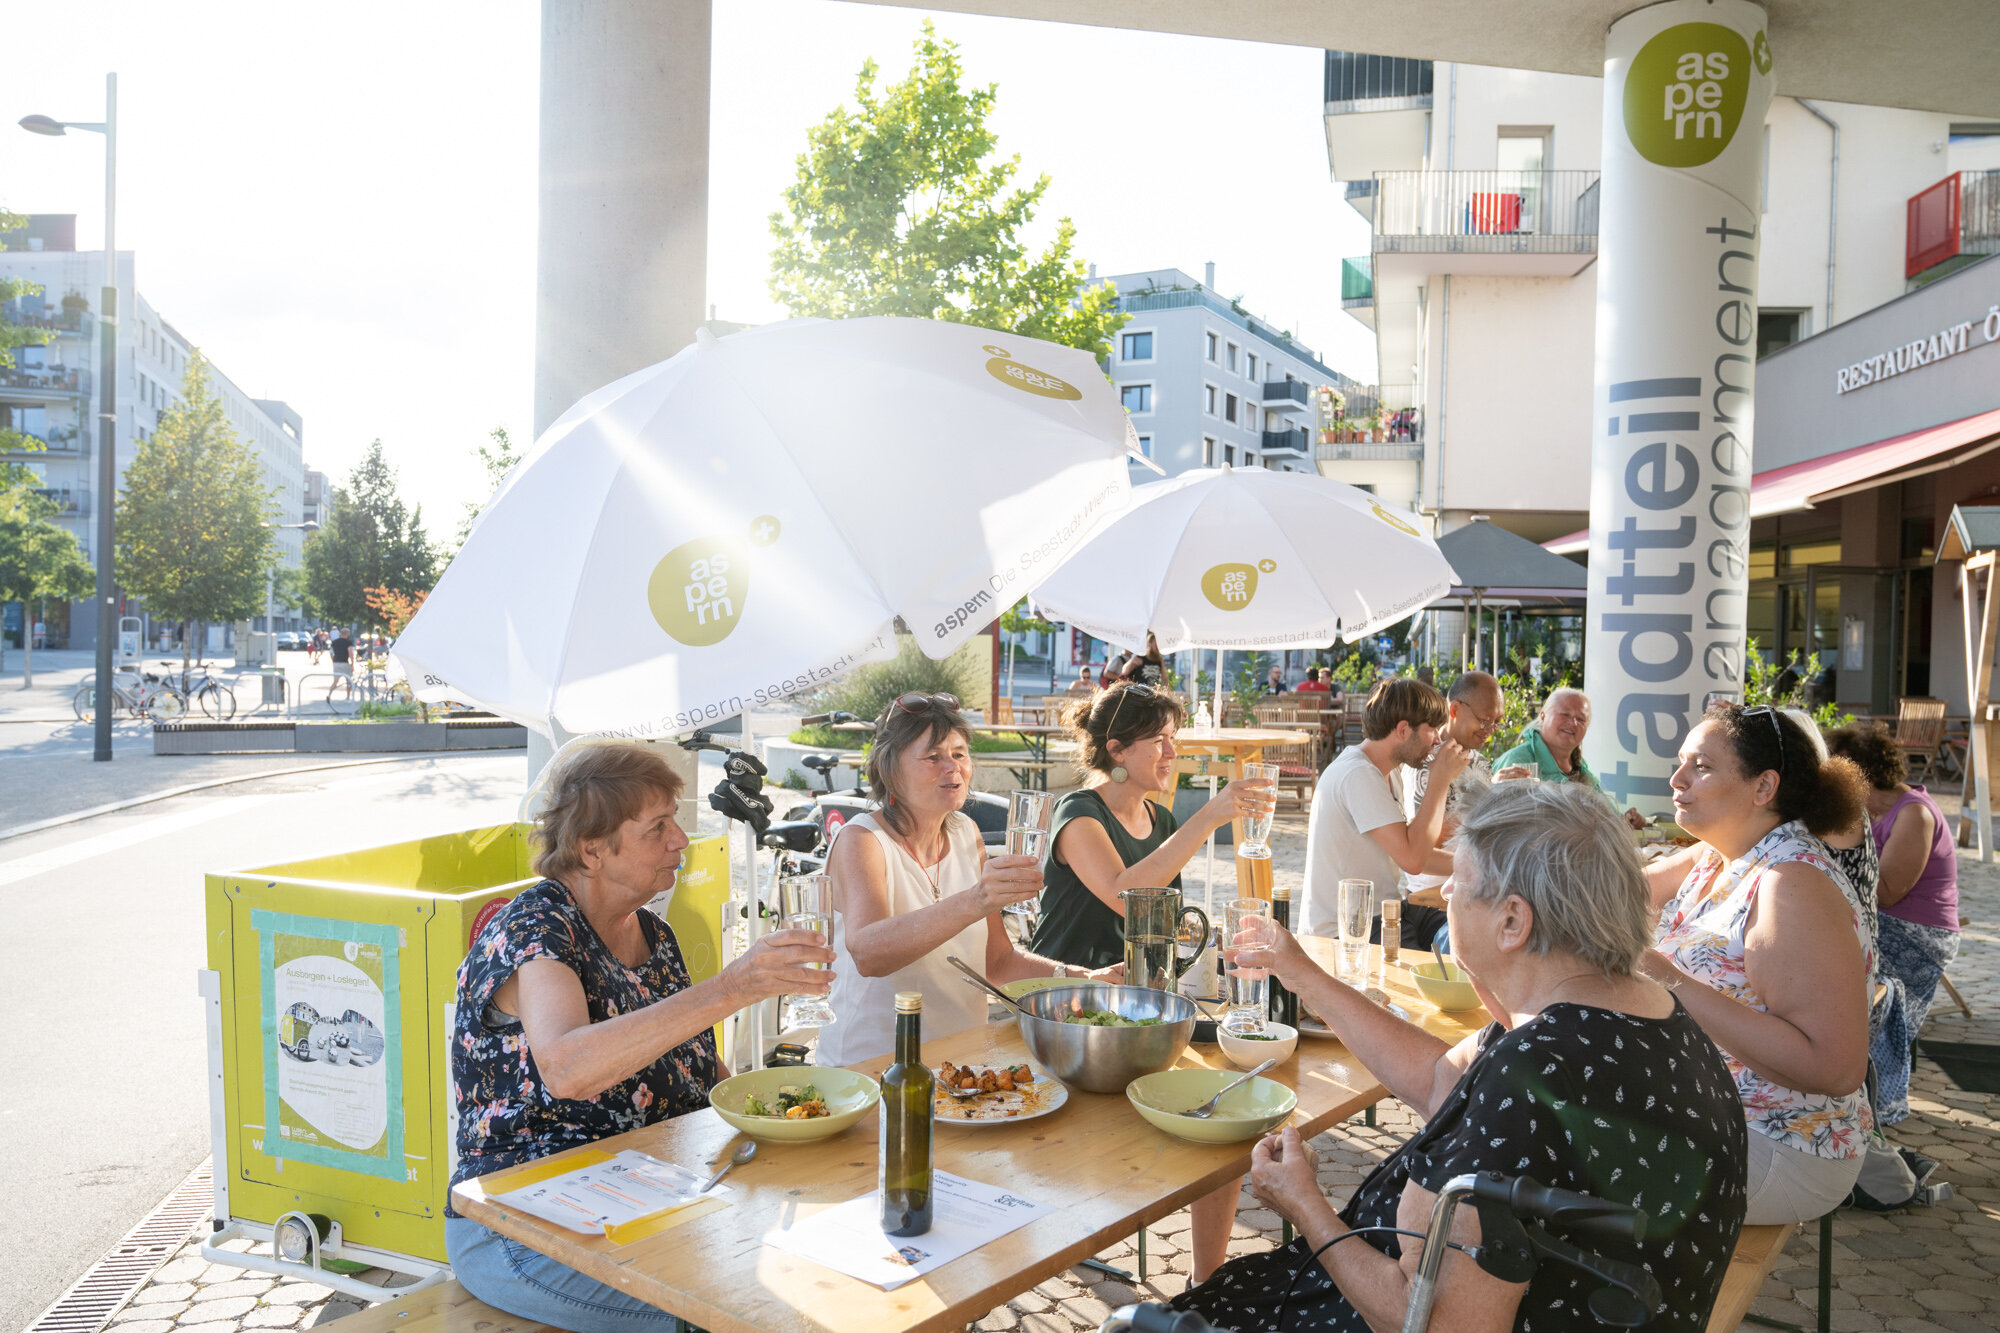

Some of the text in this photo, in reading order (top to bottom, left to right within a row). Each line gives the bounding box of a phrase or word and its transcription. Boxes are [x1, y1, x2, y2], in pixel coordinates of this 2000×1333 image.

[1836, 321, 1973, 395] RESTAURANT
[934, 589, 992, 639] aspern
[989, 566, 1017, 594] Die
[1345, 615, 1378, 634] aspen
[1600, 377, 1702, 820] tadtteil
[286, 968, 326, 982] Ausborgen
